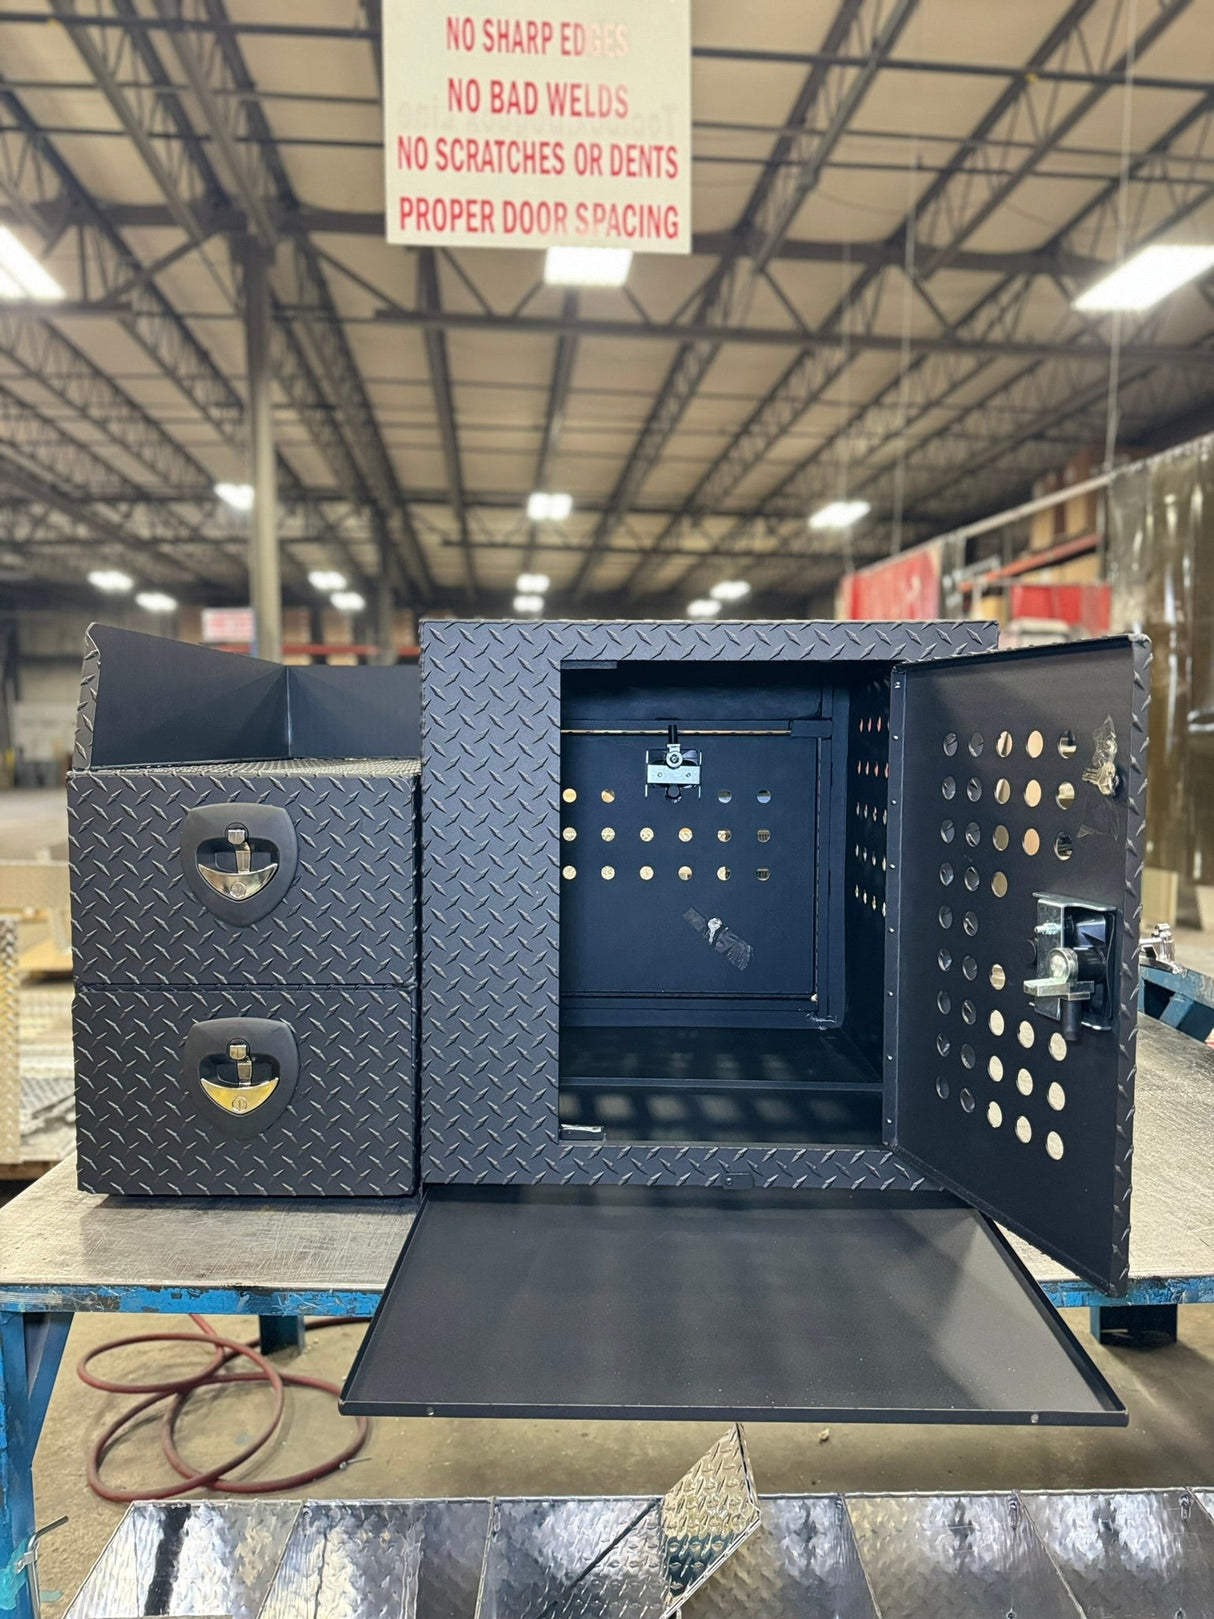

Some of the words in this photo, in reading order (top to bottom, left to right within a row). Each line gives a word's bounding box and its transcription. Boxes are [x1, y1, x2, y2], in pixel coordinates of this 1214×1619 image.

[446, 16, 476, 52] NO
[483, 18, 554, 54] SHARP
[560, 21, 629, 57] EDGES
[448, 77, 482, 114] NO
[490, 79, 539, 116] BAD
[546, 82, 628, 120] WELDS
[397, 135, 429, 171] NO
[435, 136, 566, 176] SCRATCHES
[574, 142, 603, 177] OR
[609, 143, 679, 181] DENTS
[399, 196, 495, 234] PROPER
[502, 200, 568, 235] DOOR
[575, 202, 680, 240] SPACING
